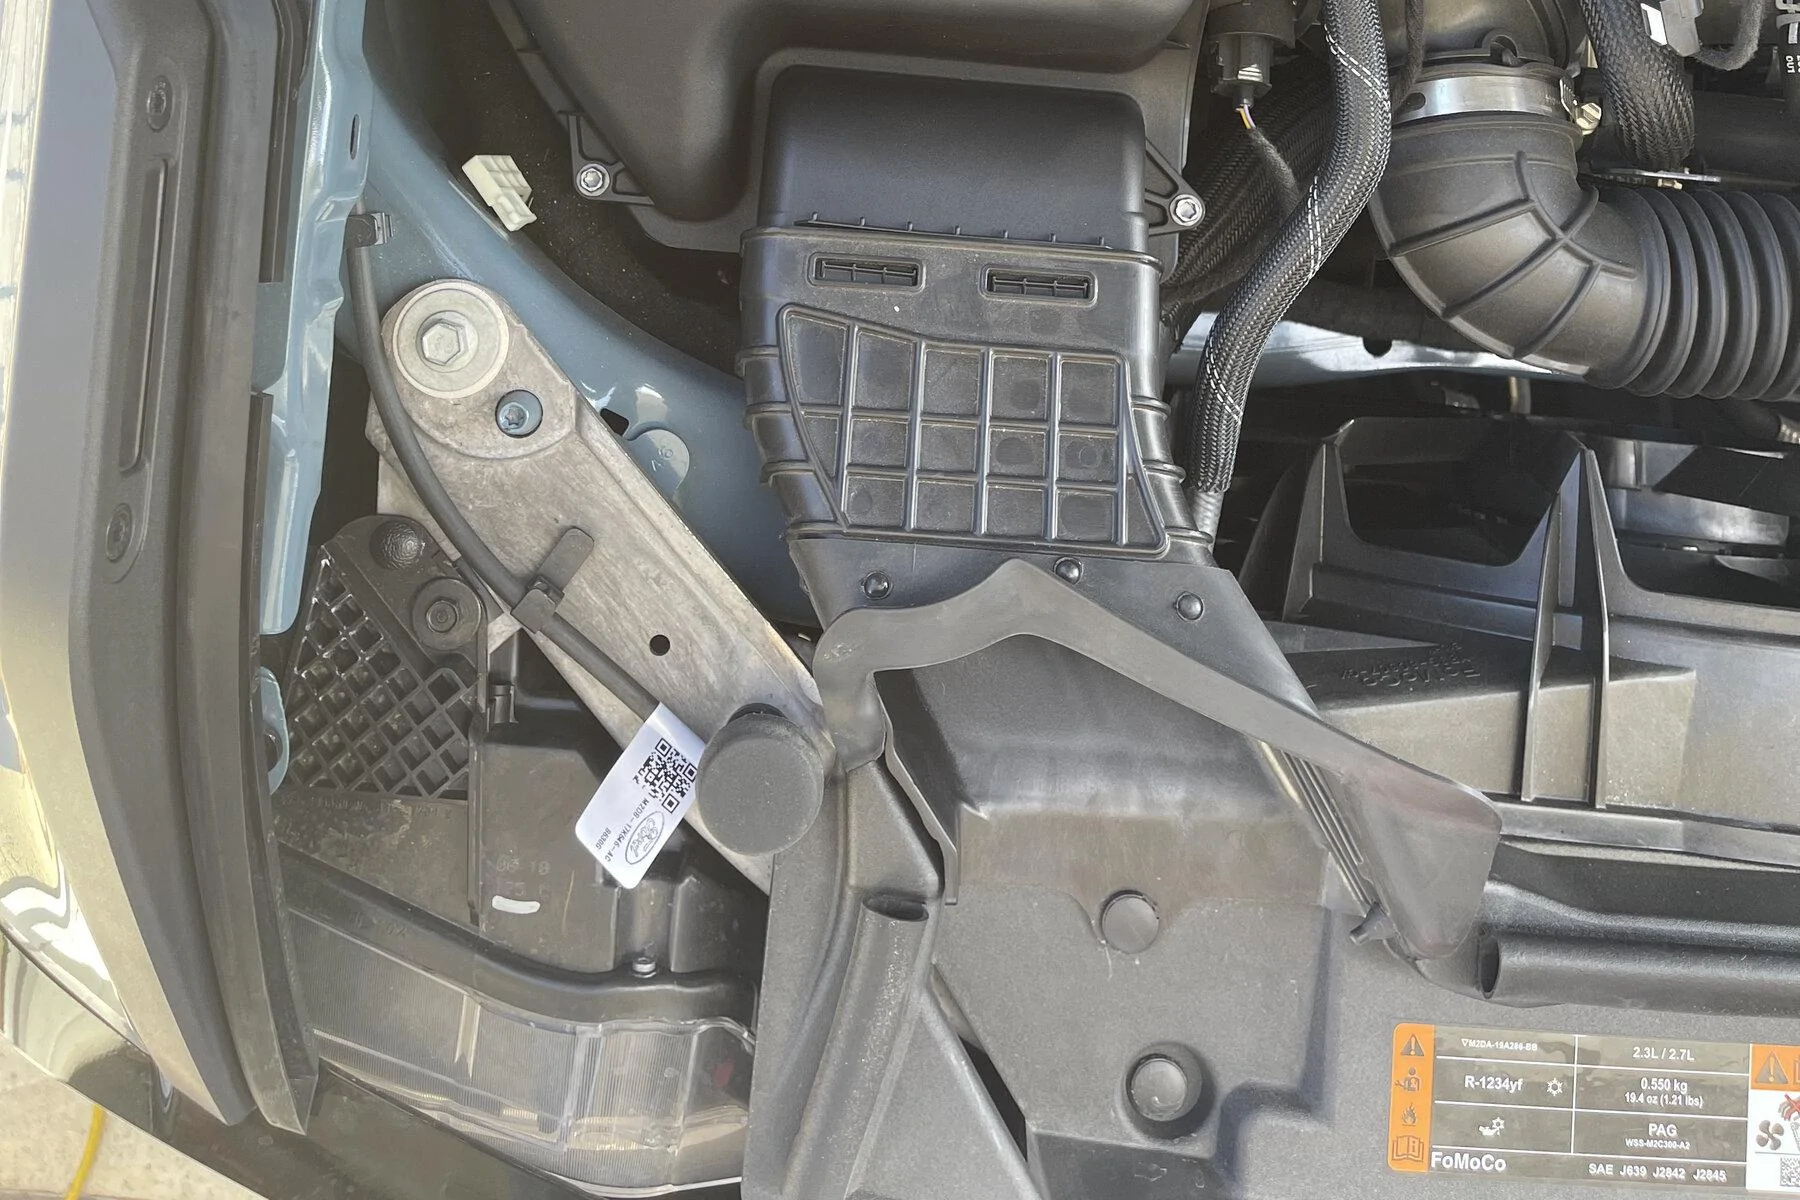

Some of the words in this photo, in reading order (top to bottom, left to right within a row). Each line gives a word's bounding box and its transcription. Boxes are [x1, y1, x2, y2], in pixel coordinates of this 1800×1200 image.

[1632, 1046, 1659, 1059] 2.3L
[1668, 1048, 1695, 1061] 2.7L
[1464, 1075, 1524, 1093] R-1234yf
[1640, 1077, 1671, 1091] 0.550
[1673, 1078, 1688, 1095] kg
[1624, 1091, 1644, 1104] 19.4
[1646, 1095, 1658, 1104] oz
[1660, 1094, 1683, 1108] (1.21
[1685, 1095, 1704, 1109] lbs)
[1648, 1123, 1678, 1137] PAG
[1430, 1151, 1507, 1171] FoMoCo
[1588, 1163, 1614, 1176] SAE
[1620, 1164, 1647, 1177] J639
[1653, 1166, 1686, 1180] J2842
[1692, 1168, 1727, 1183] J2845
